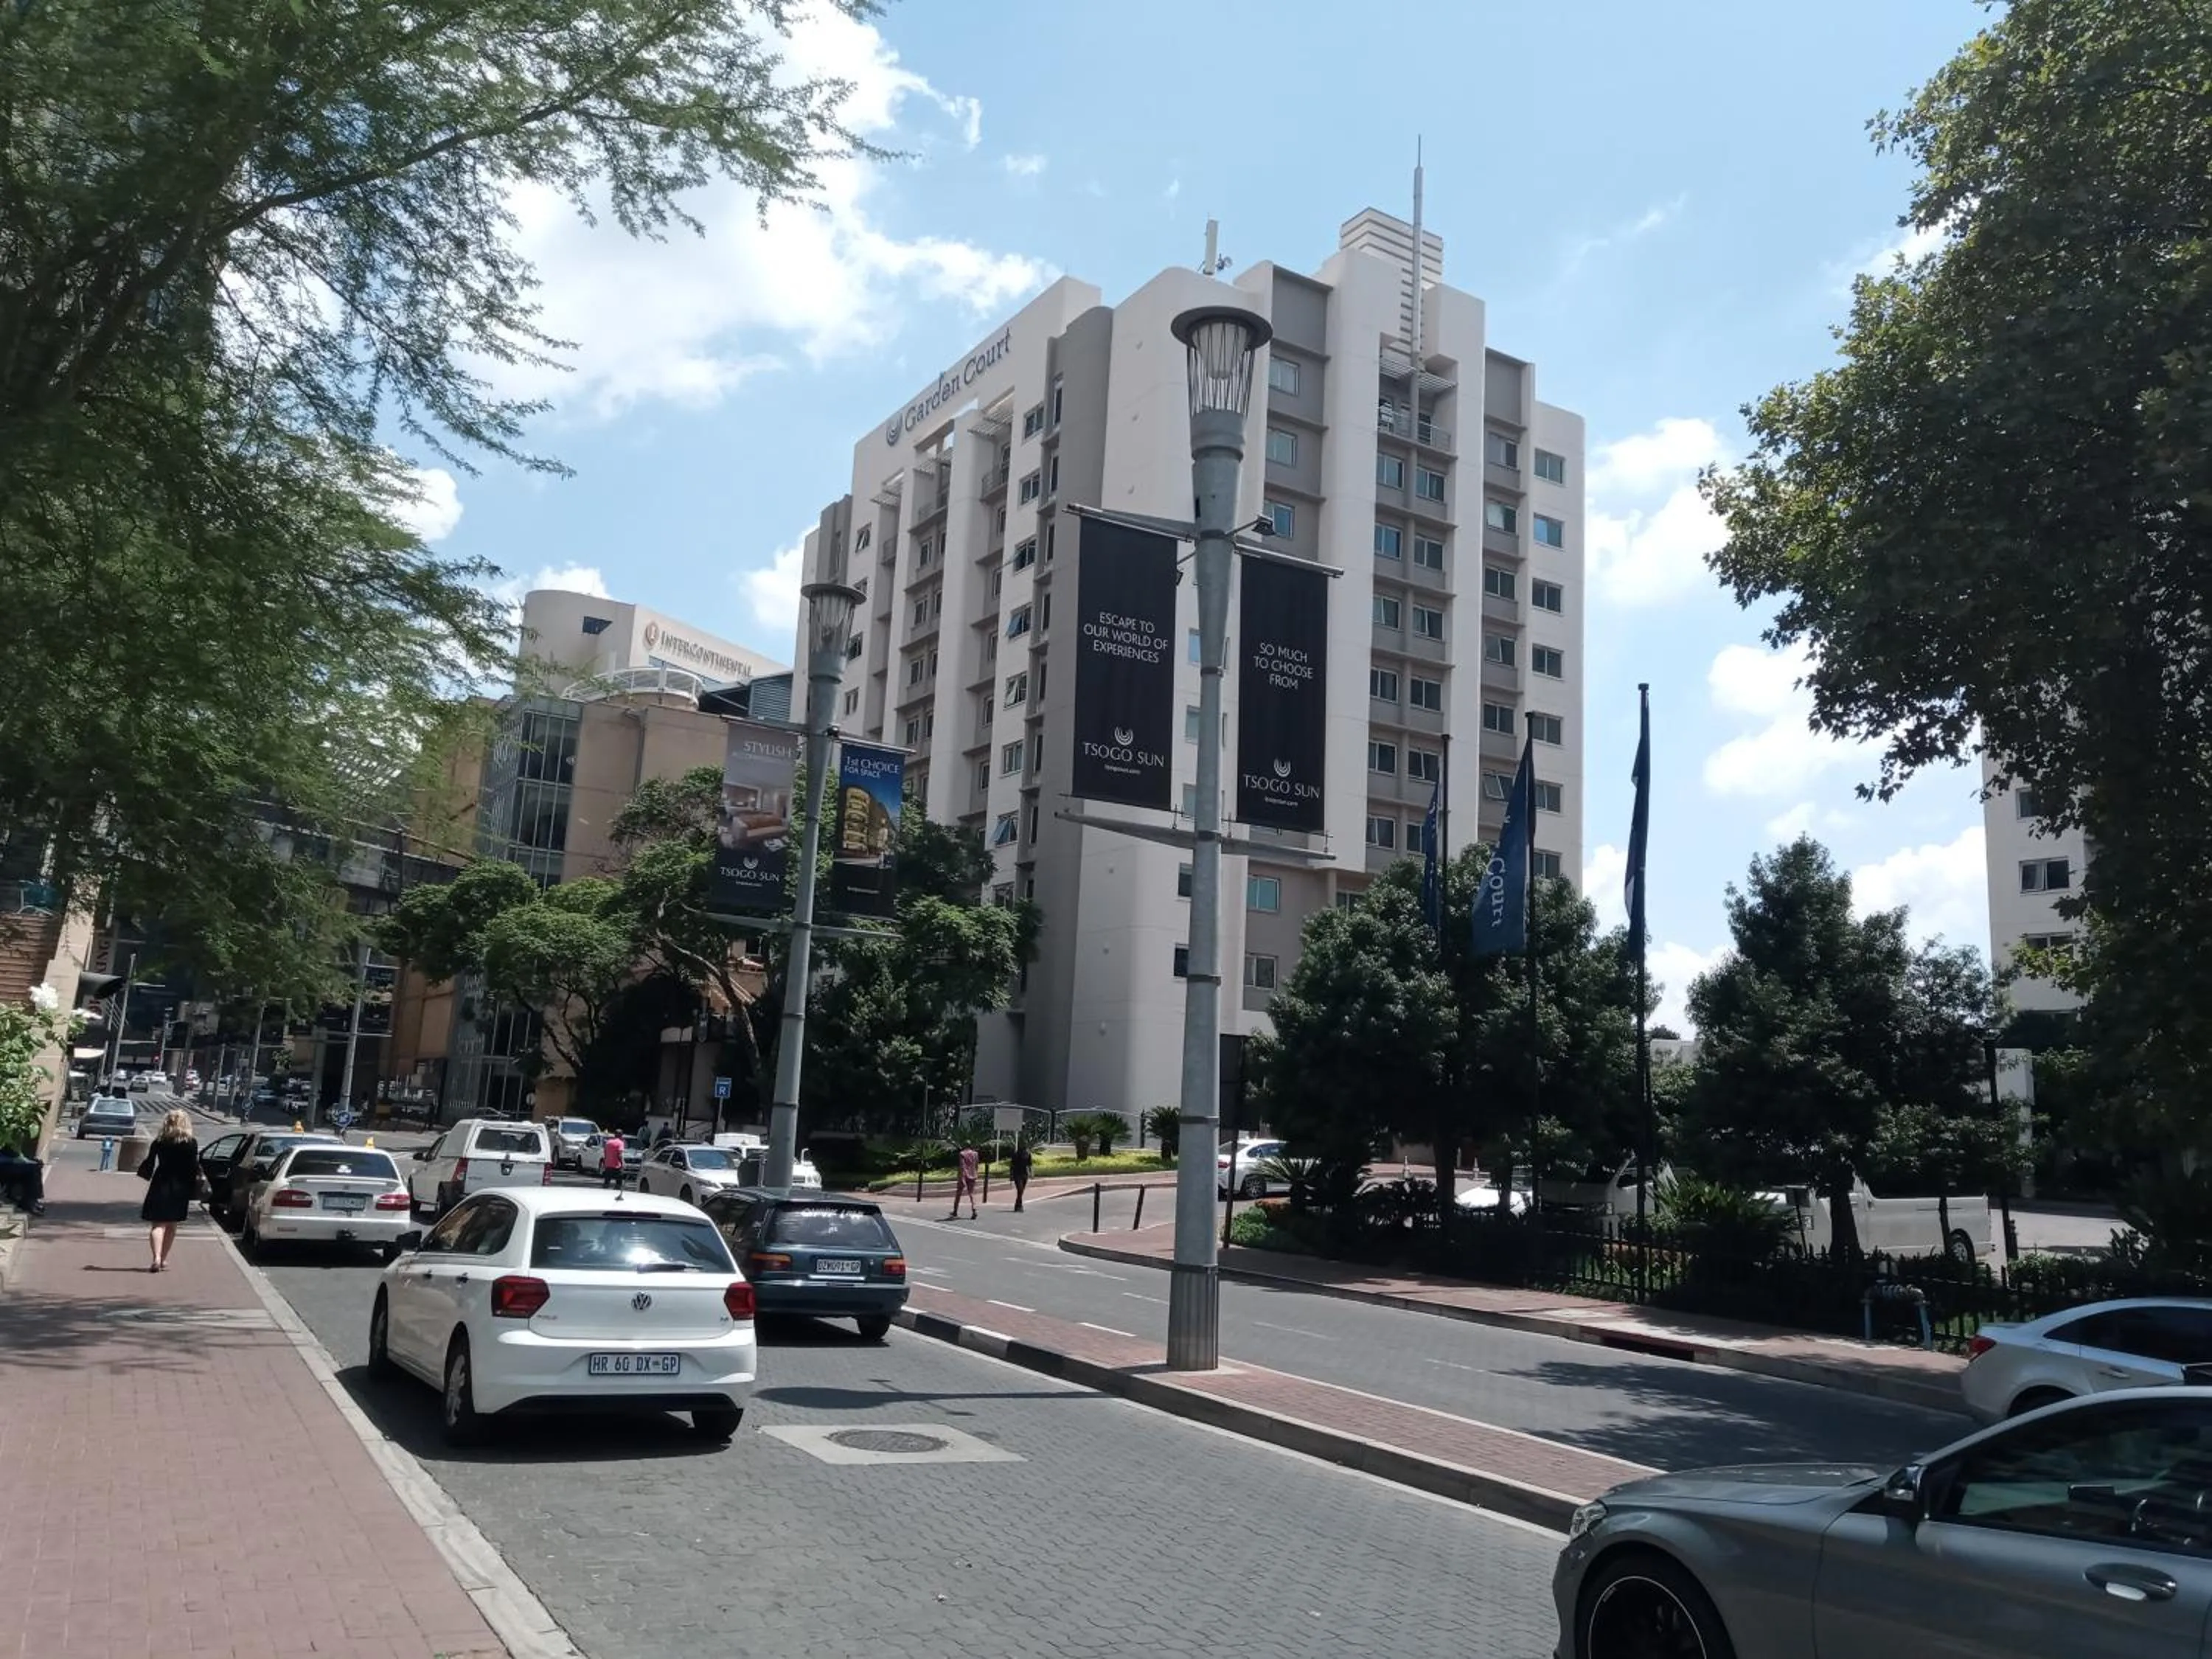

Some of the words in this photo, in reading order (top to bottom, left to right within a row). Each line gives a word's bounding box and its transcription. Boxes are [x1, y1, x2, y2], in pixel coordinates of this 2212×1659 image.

[905, 375, 961, 432] Garden
[963, 326, 1011, 386] Court
[1099, 611, 1136, 630] ESCAPE
[1140, 620, 1155, 633] TO
[1083, 623, 1109, 639] OUR
[1112, 628, 1151, 647] WORLD
[1153, 638, 1168, 650] OF
[1093, 639, 1160, 664] EXPERIENCES
[1259, 642, 1275, 655] SO
[1278, 646, 1307, 663] MUCH
[1253, 655, 1269, 669] TO
[1271, 660, 1313, 679] CHOOSE
[1269, 673, 1298, 689] FROM
[742, 742, 793, 758] STYLISH
[1083, 742, 1133, 762] TSOGO
[1138, 751, 1164, 768] SUN
[860, 759, 900, 774] CHOICE
[1243, 774, 1290, 794] TSOGO
[1294, 782, 1320, 799] SUN
[720, 866, 757, 880] TSOGO
[759, 871, 779, 883] SUN
[719, 1086, 726, 1095] R
[593, 1356, 608, 1371] HR
[661, 1356, 676, 1371] GP
